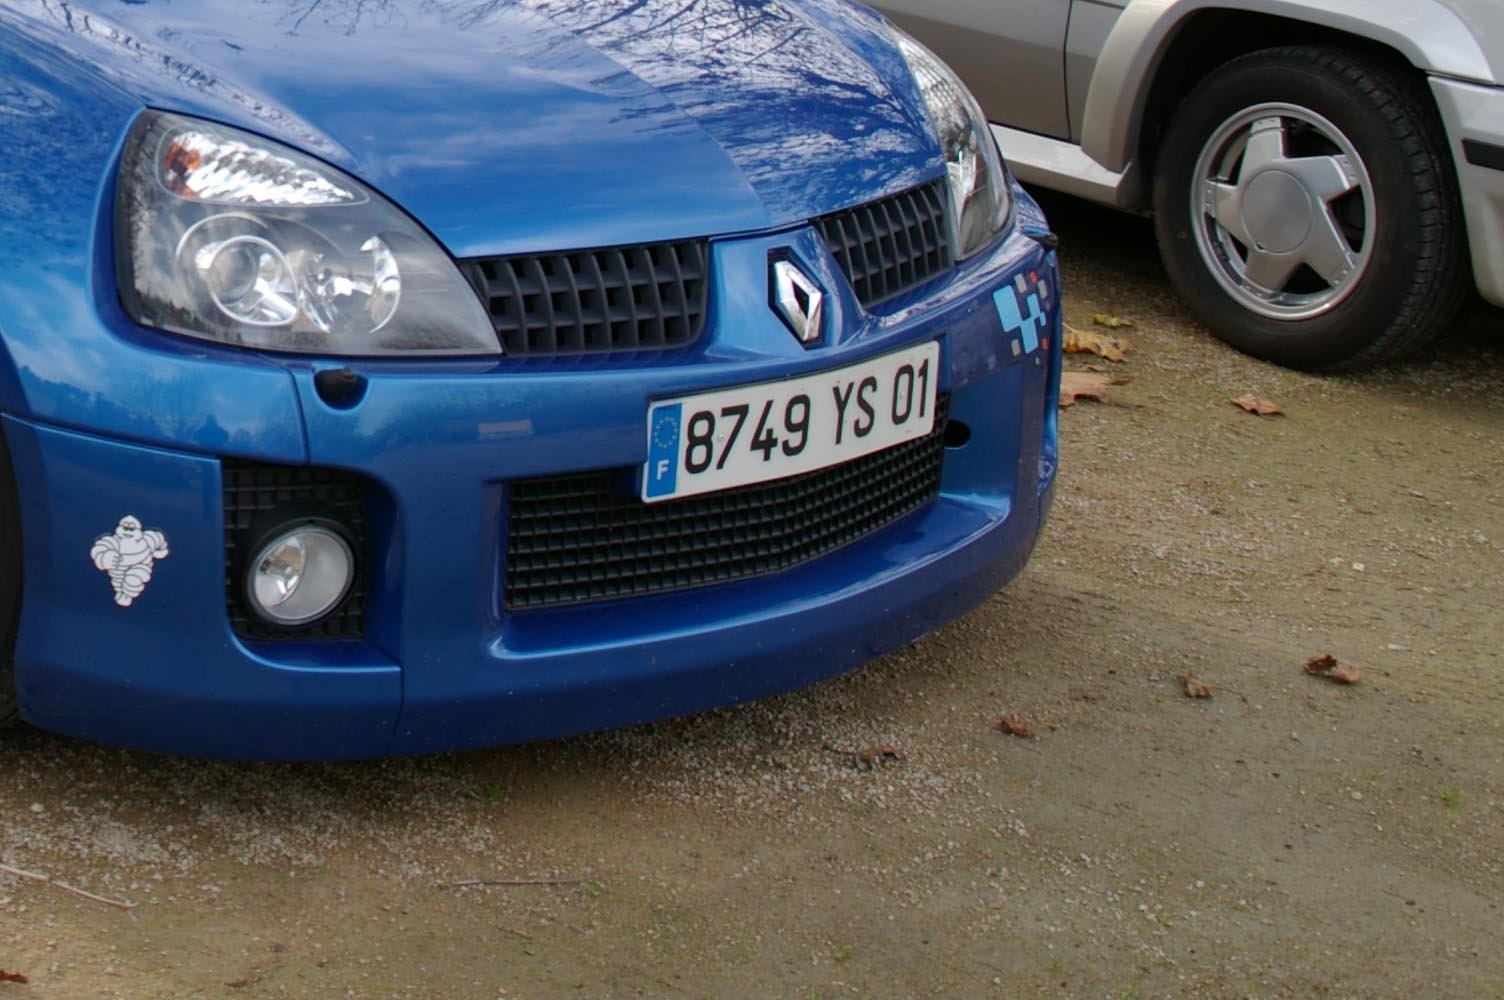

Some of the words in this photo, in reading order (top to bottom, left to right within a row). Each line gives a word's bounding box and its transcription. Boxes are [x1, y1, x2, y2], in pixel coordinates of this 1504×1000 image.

[683, 393, 812, 475] 8749
[832, 375, 878, 446] YS
[891, 358, 930, 426] 01
[655, 458, 670, 481] F
